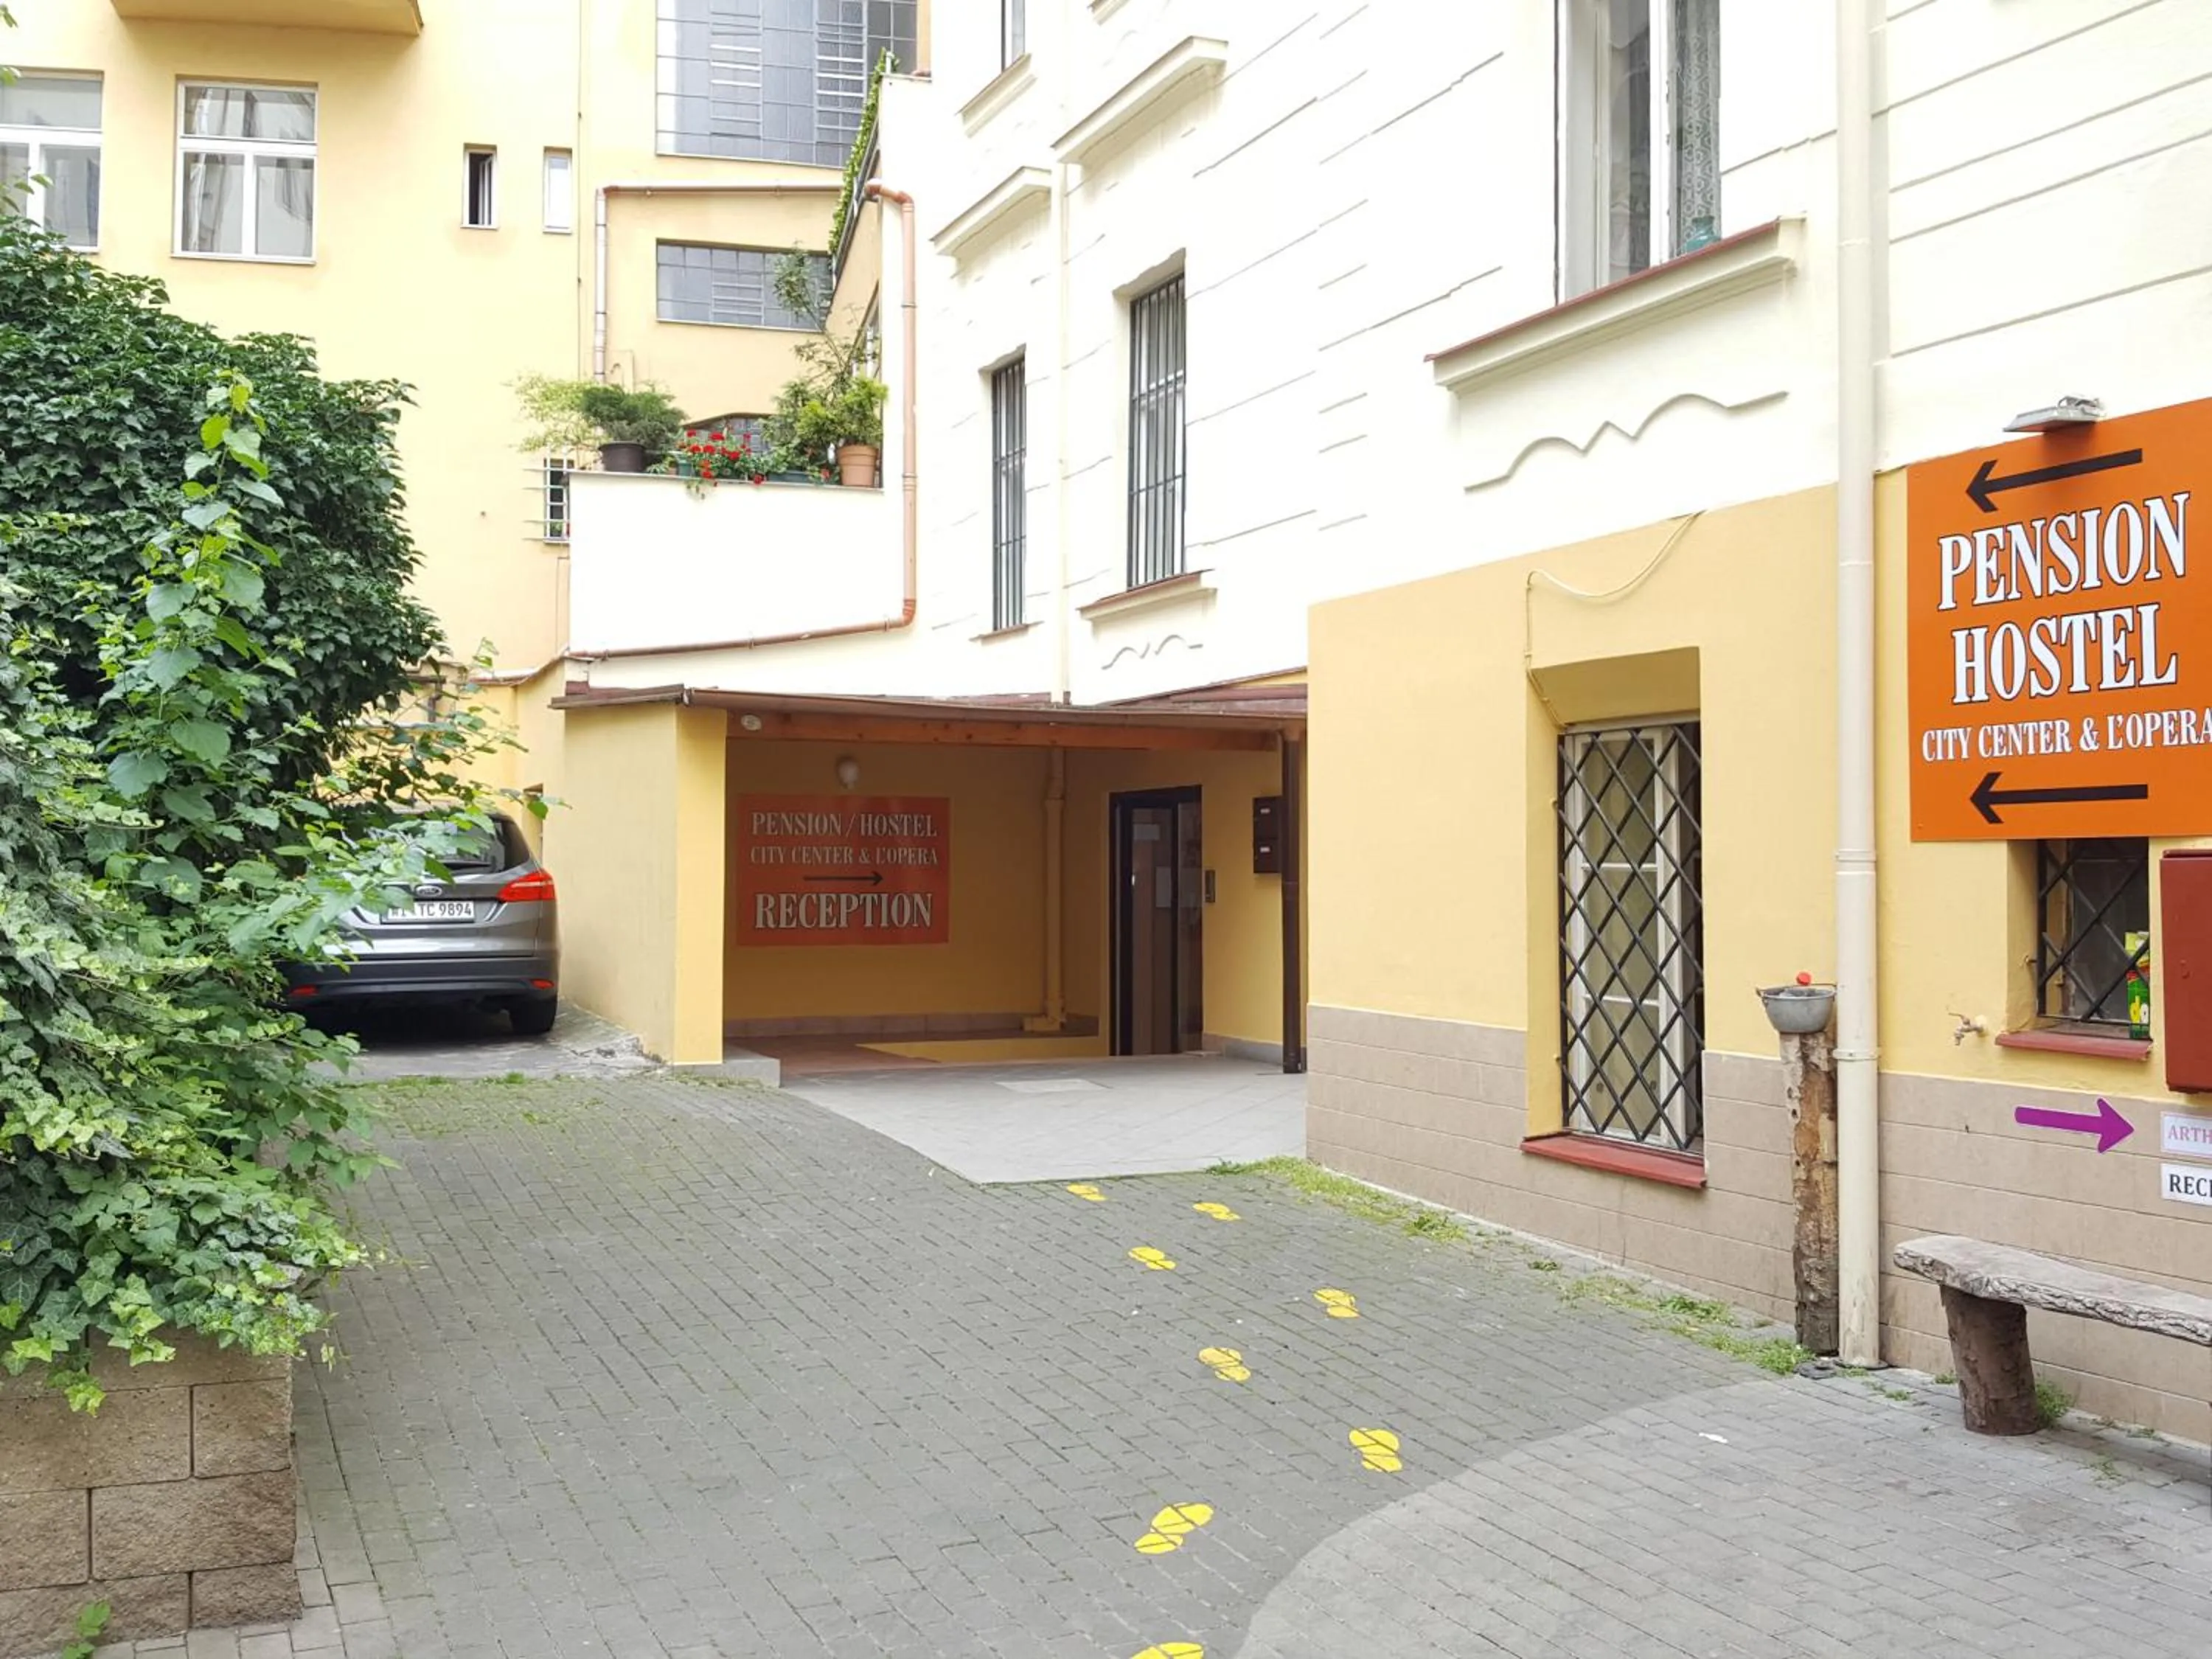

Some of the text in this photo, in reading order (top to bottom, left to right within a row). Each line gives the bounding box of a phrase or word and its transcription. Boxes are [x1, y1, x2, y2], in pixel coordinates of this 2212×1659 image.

[1937, 491, 2191, 611] PENSION
[1951, 602, 2177, 704] HOSTEL
[1921, 726, 1972, 761] CITY
[1978, 717, 2073, 758] CENTER
[2079, 715, 2100, 751] &
[752, 812, 841, 835] PENSION
[860, 813, 938, 837] HOSTEL
[751, 846, 786, 864] CITY
[790, 846, 853, 864] CENTER
[858, 847, 872, 864] &
[418, 903, 435, 916] TC
[439, 902, 471, 916] 9894
[754, 892, 933, 928] RECEPTION
